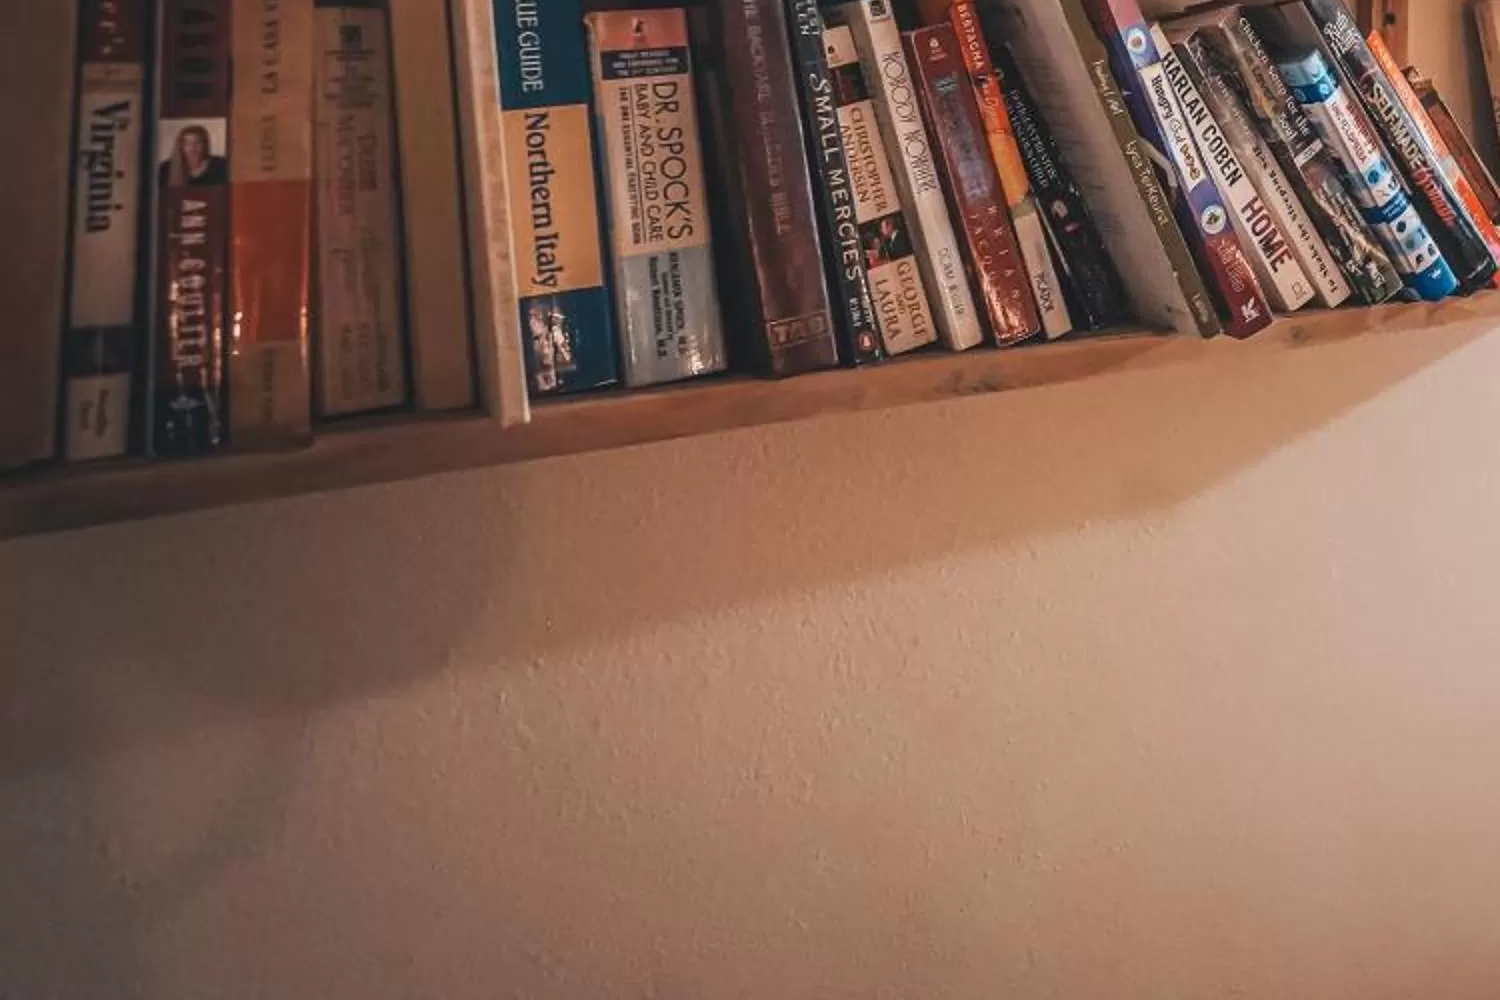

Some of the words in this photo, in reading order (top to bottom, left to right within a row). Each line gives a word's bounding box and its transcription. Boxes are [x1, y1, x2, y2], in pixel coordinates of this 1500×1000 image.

[519, 32, 544, 92] GUIDE
[1237, 15, 1271, 64] Chicken
[1264, 64, 1288, 97] Soup
[635, 84, 650, 123] BABY
[651, 81, 680, 126] DR.
[1149, 74, 1175, 120] Hungry
[82, 101, 131, 233] Virginia
[638, 124, 656, 157] AND
[840, 126, 869, 207] ANDERSEN
[849, 107, 886, 212] CHRISTOPHER
[1158, 51, 1208, 126] HARLAN
[1200, 125, 1244, 187] COBEN
[1238, 197, 1294, 273] HOME
[525, 114, 553, 229] Northern
[642, 160, 660, 202] CHILD
[656, 127, 694, 240] SPOCK'S
[809, 74, 835, 163] SMALL
[829, 169, 860, 282] MERCIES
[180, 199, 207, 245] ANN
[646, 204, 664, 242] CARE
[533, 230, 564, 287] Italy
[876, 280, 899, 341] LAURA
[896, 261, 928, 338] GEORGE
